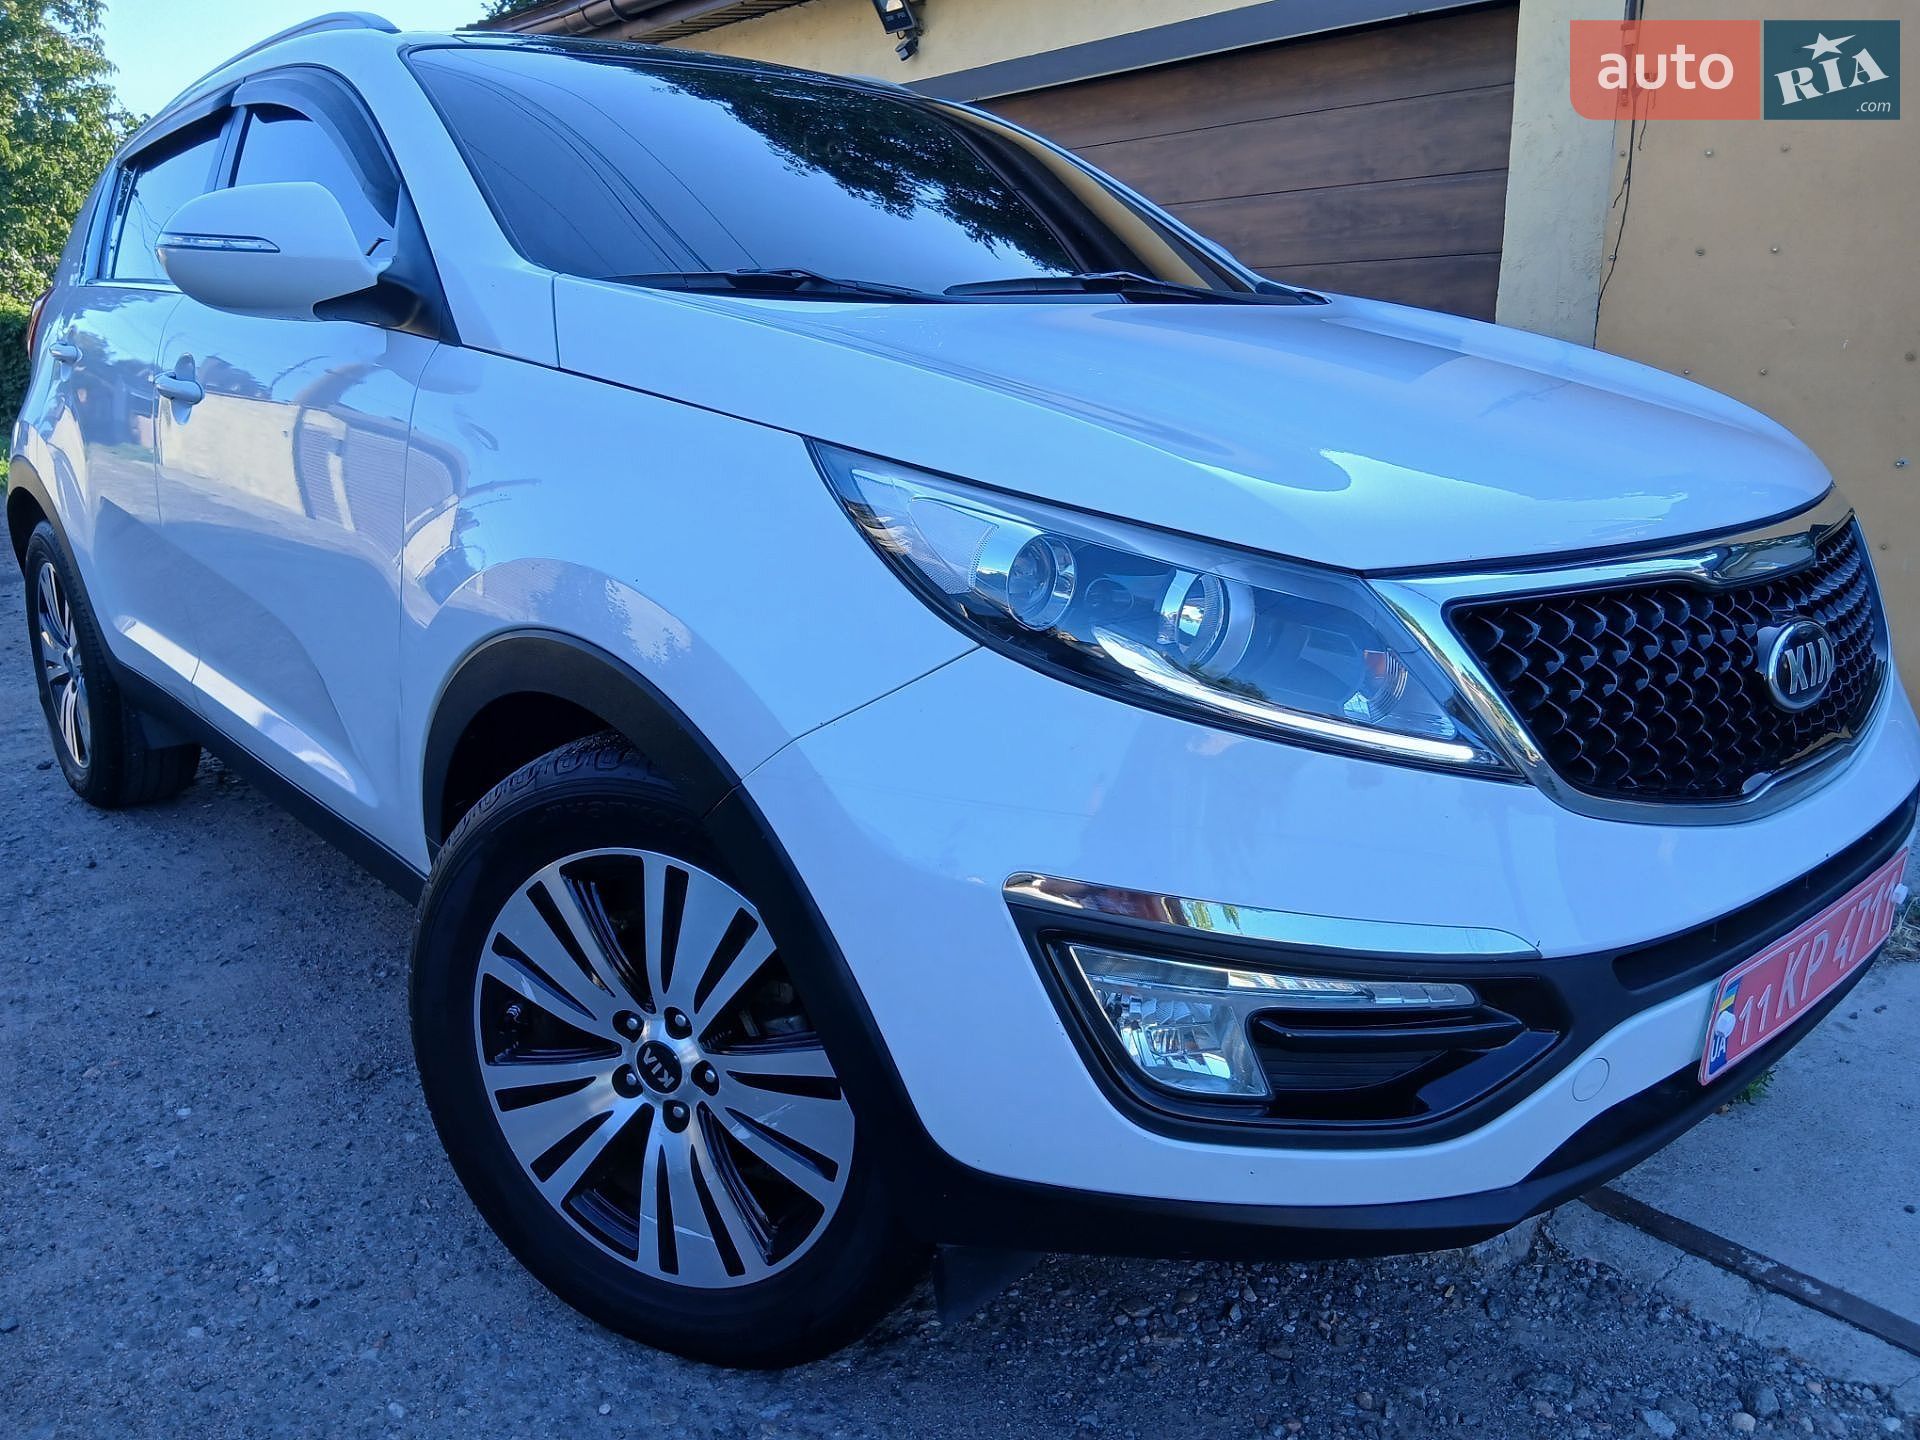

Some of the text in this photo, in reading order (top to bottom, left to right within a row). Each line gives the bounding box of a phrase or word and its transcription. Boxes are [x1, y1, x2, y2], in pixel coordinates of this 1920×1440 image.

[1784, 637, 1833, 695] KIA
[1739, 984, 1772, 1046] 11
[1776, 929, 1830, 1020] KP
[643, 1046, 676, 1089] KIA
[1710, 1036, 1727, 1063] UA
